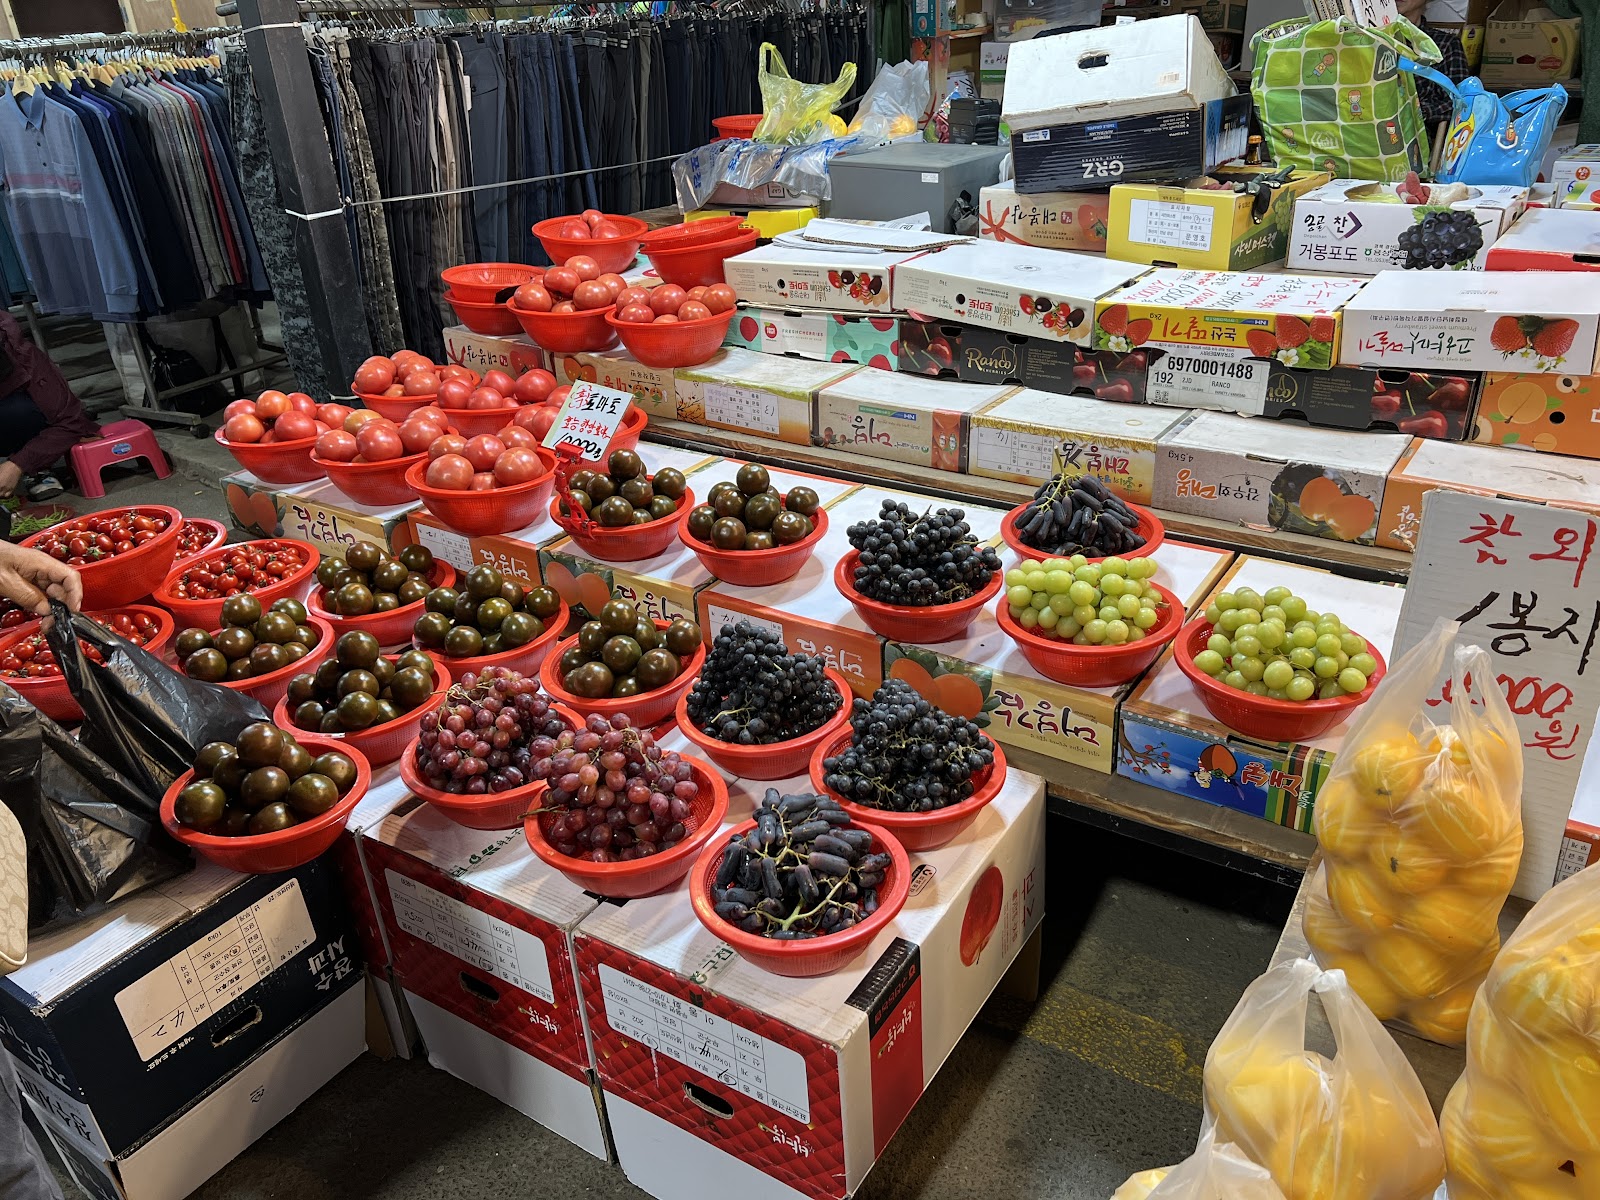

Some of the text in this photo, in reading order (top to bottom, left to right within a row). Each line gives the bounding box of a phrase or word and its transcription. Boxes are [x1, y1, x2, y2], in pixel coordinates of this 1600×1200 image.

[1082, 160, 1124, 179] GRZ
[1299, 243, 1358, 262] 거봉포도
[788, 281, 809, 291] 토마토
[968, 298, 993, 312] 토마토
[1149, 312, 1162, 320] 2kg
[1162, 316, 1237, 342] 논산 딸기
[1394, 323, 1428, 331] strawberry
[964, 347, 1012, 370] Ranco
[1199, 350, 1235, 358] STRAWBERRY
[1154, 371, 1174, 385] 192
[1167, 356, 1254, 380] 6970001488
[1211, 380, 1231, 389] RANCO
[851, 415, 893, 447] 대봉
[995, 427, 1009, 445] 14
[1060, 442, 1130, 475] 대봉감
[1174, 468, 1259, 502] 감우회 대봉
[292, 505, 356, 547] 대봉감
[1459, 513, 1596, 589] 참외
[993, 689, 1101, 746] 대봉감
[1523, 719, 1580, 760] 원
[307, 934, 344, 976] 사과
[314, 956, 353, 991] 장수
[735, 1032, 760, 1049] 생산자
[738, 1050, 760, 1067] 산지
[771, 1098, 807, 1121] 표준규격품
